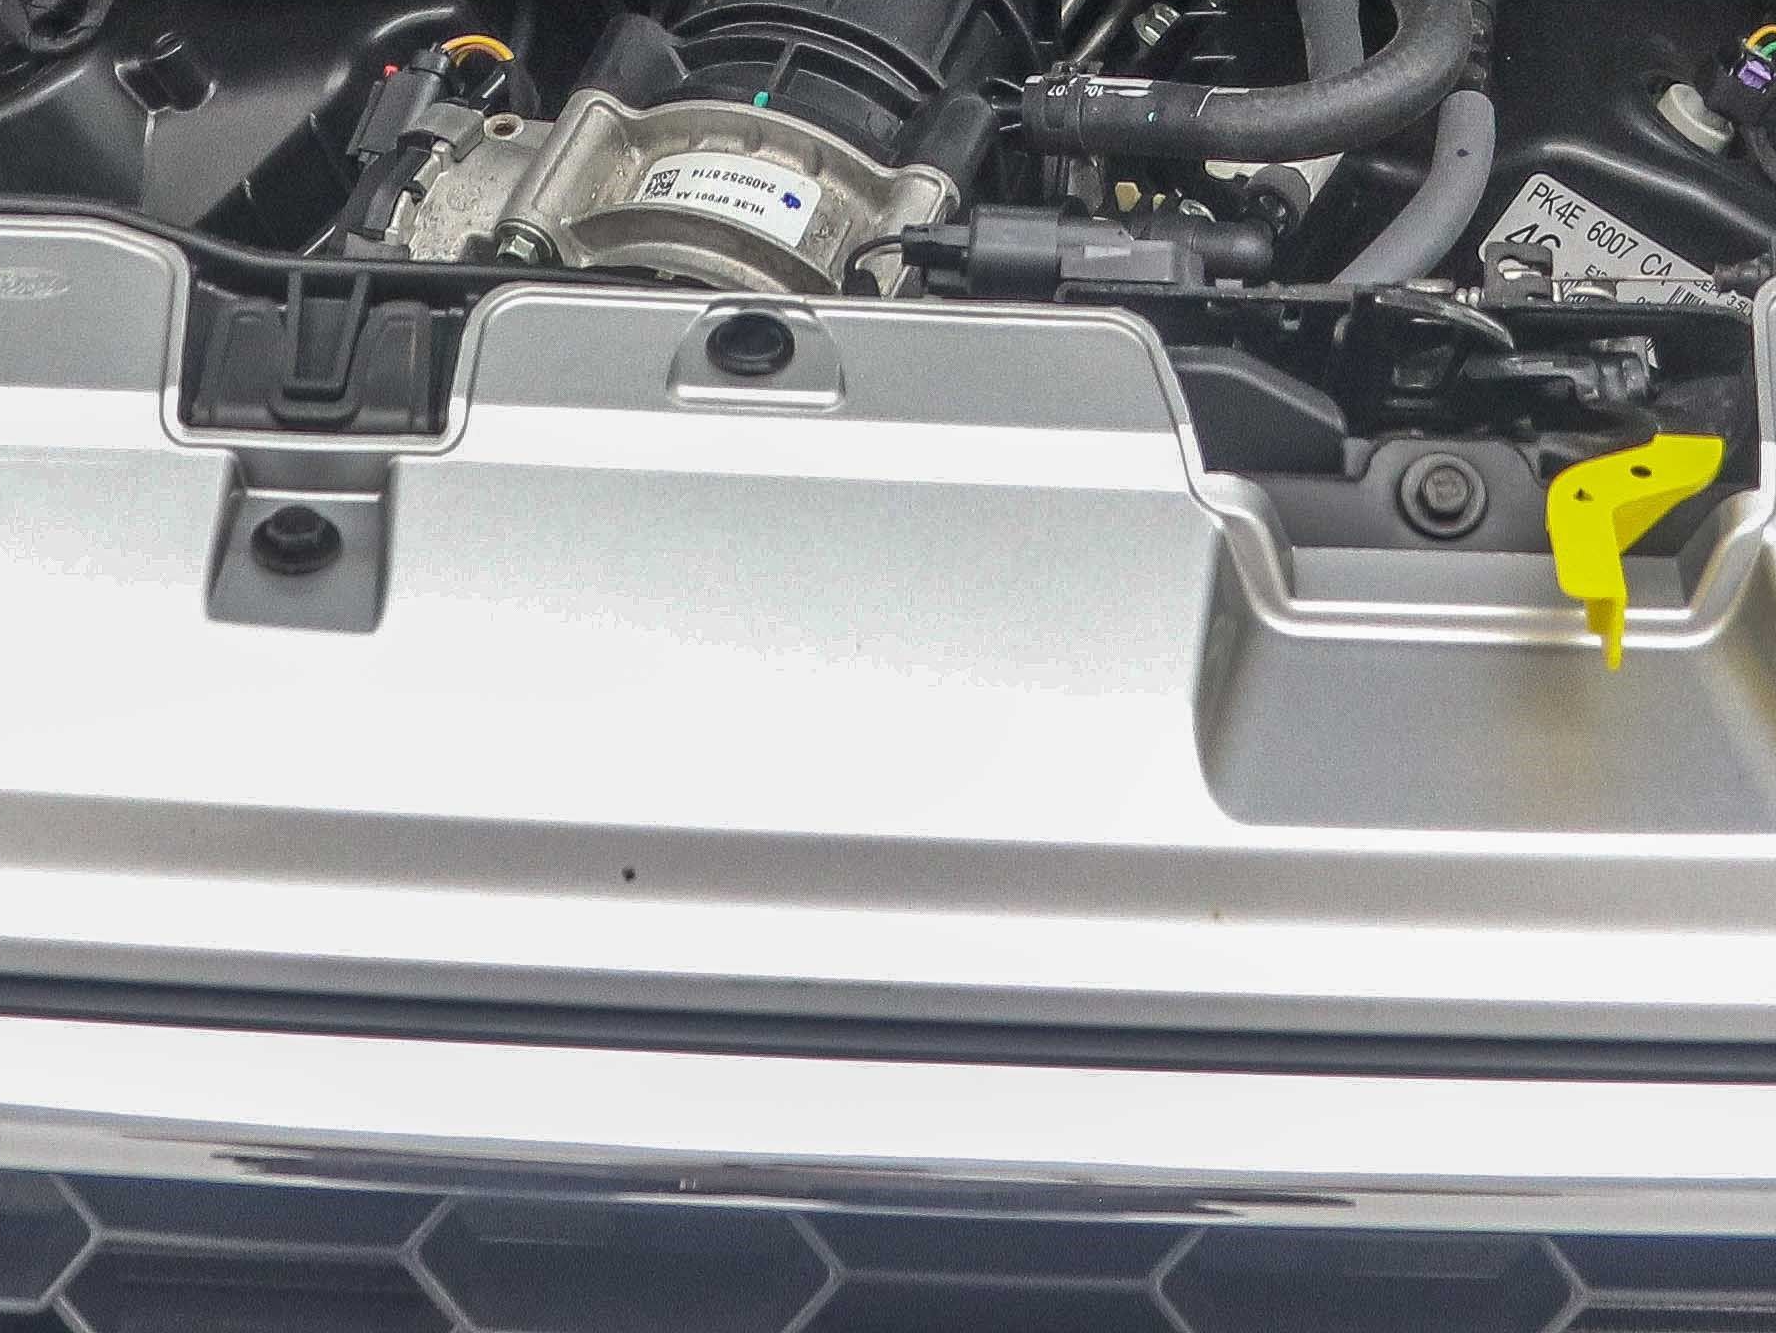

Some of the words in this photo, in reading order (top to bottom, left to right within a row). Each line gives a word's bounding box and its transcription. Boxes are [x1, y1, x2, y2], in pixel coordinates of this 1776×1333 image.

[1527, 181, 1586, 230] PK4E
[1587, 220, 1639, 259] 6007
[1639, 253, 1674, 286] CA
